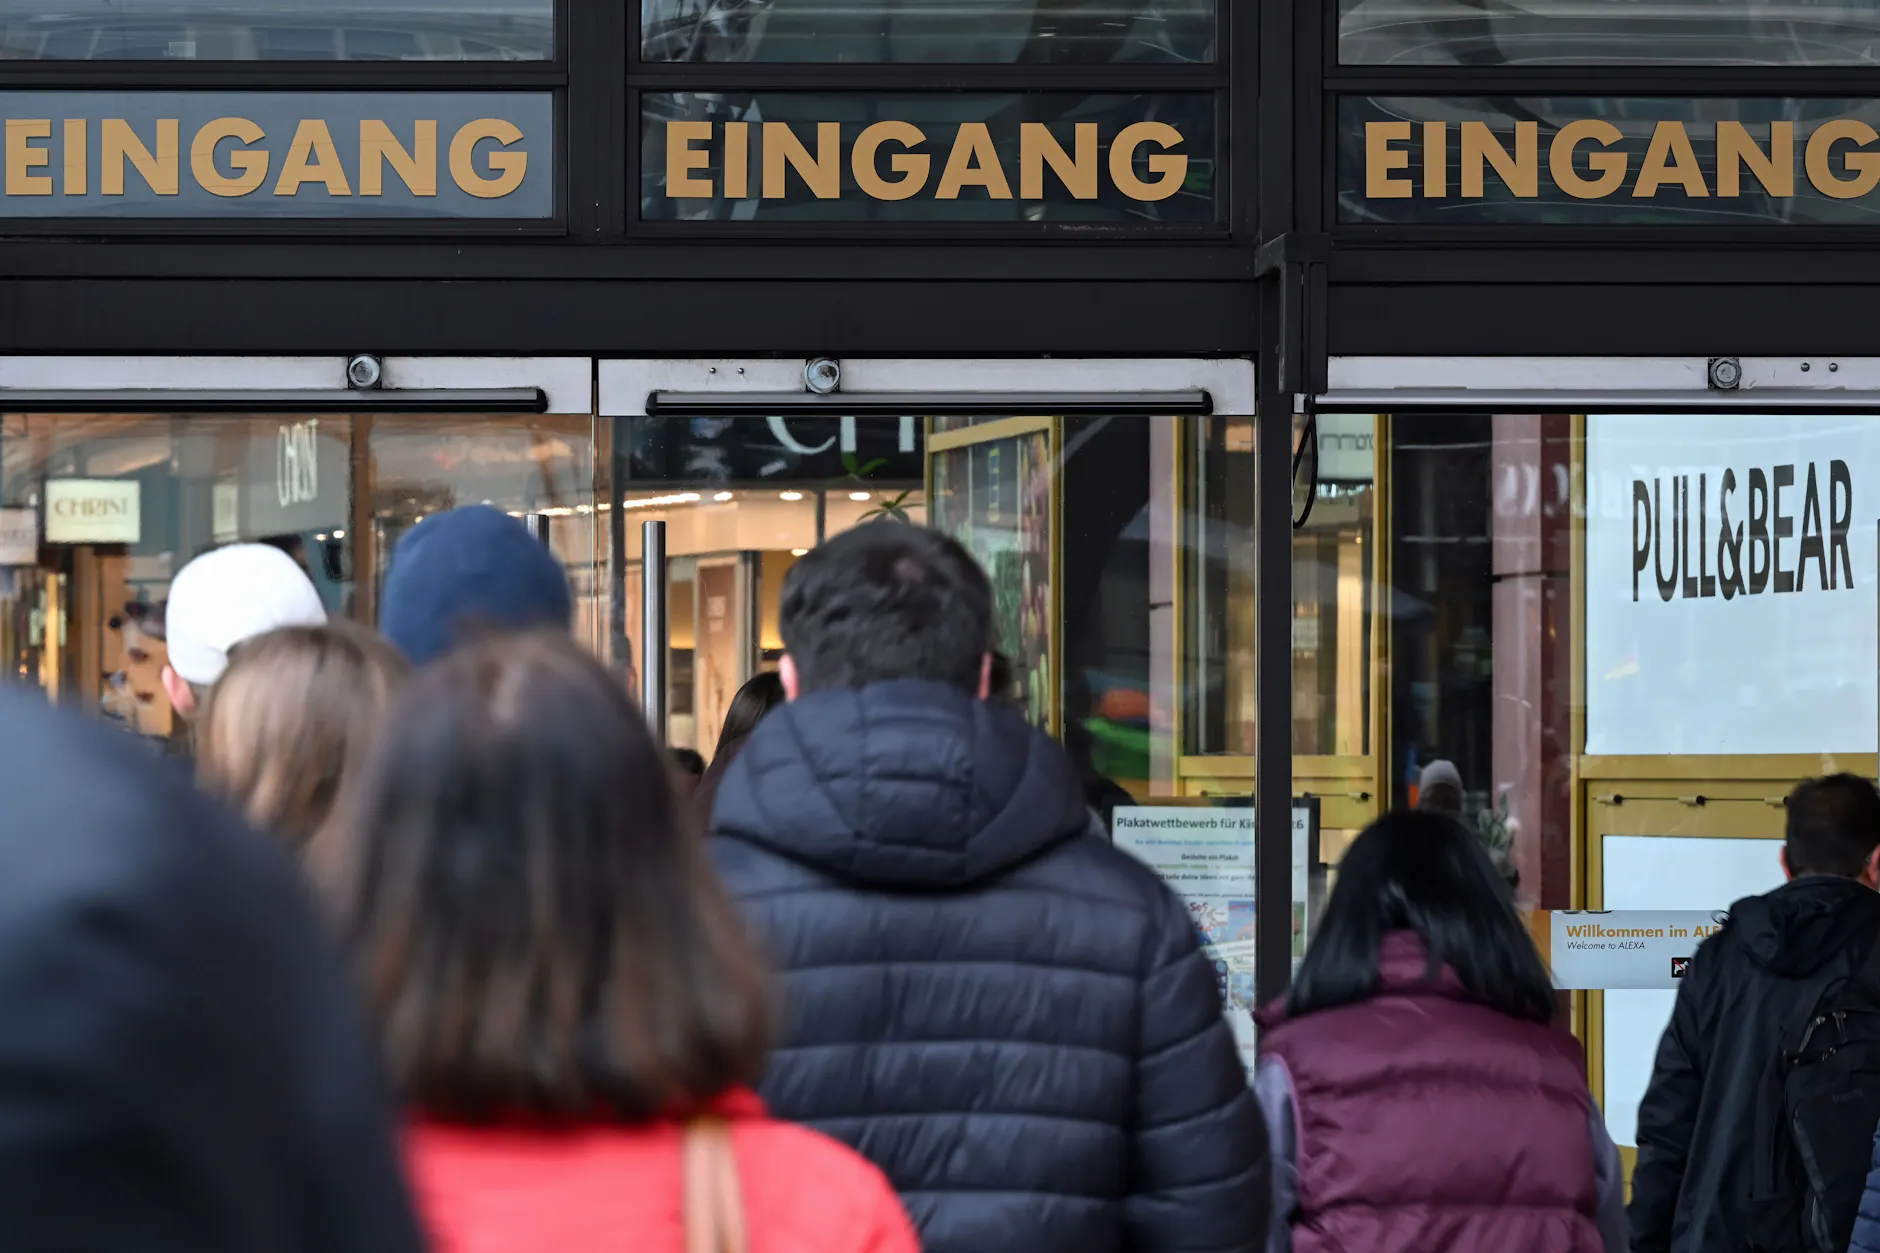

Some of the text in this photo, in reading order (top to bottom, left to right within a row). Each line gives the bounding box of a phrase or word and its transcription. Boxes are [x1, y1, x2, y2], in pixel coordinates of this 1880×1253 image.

[6, 117, 528, 199] EINGANG
[665, 120, 1189, 201] EINGANG
[1364, 118, 1880, 199] EINGANG
[1633, 460, 1854, 603] PULL&BEAR
[1116, 817, 1218, 829] Plakatwettbewerb
[1220, 817, 1236, 829] für
[1566, 924, 1664, 938] Willkommen
[1669, 924, 1688, 938] im
[1566, 941, 1646, 951] Welcome to ALEXA
